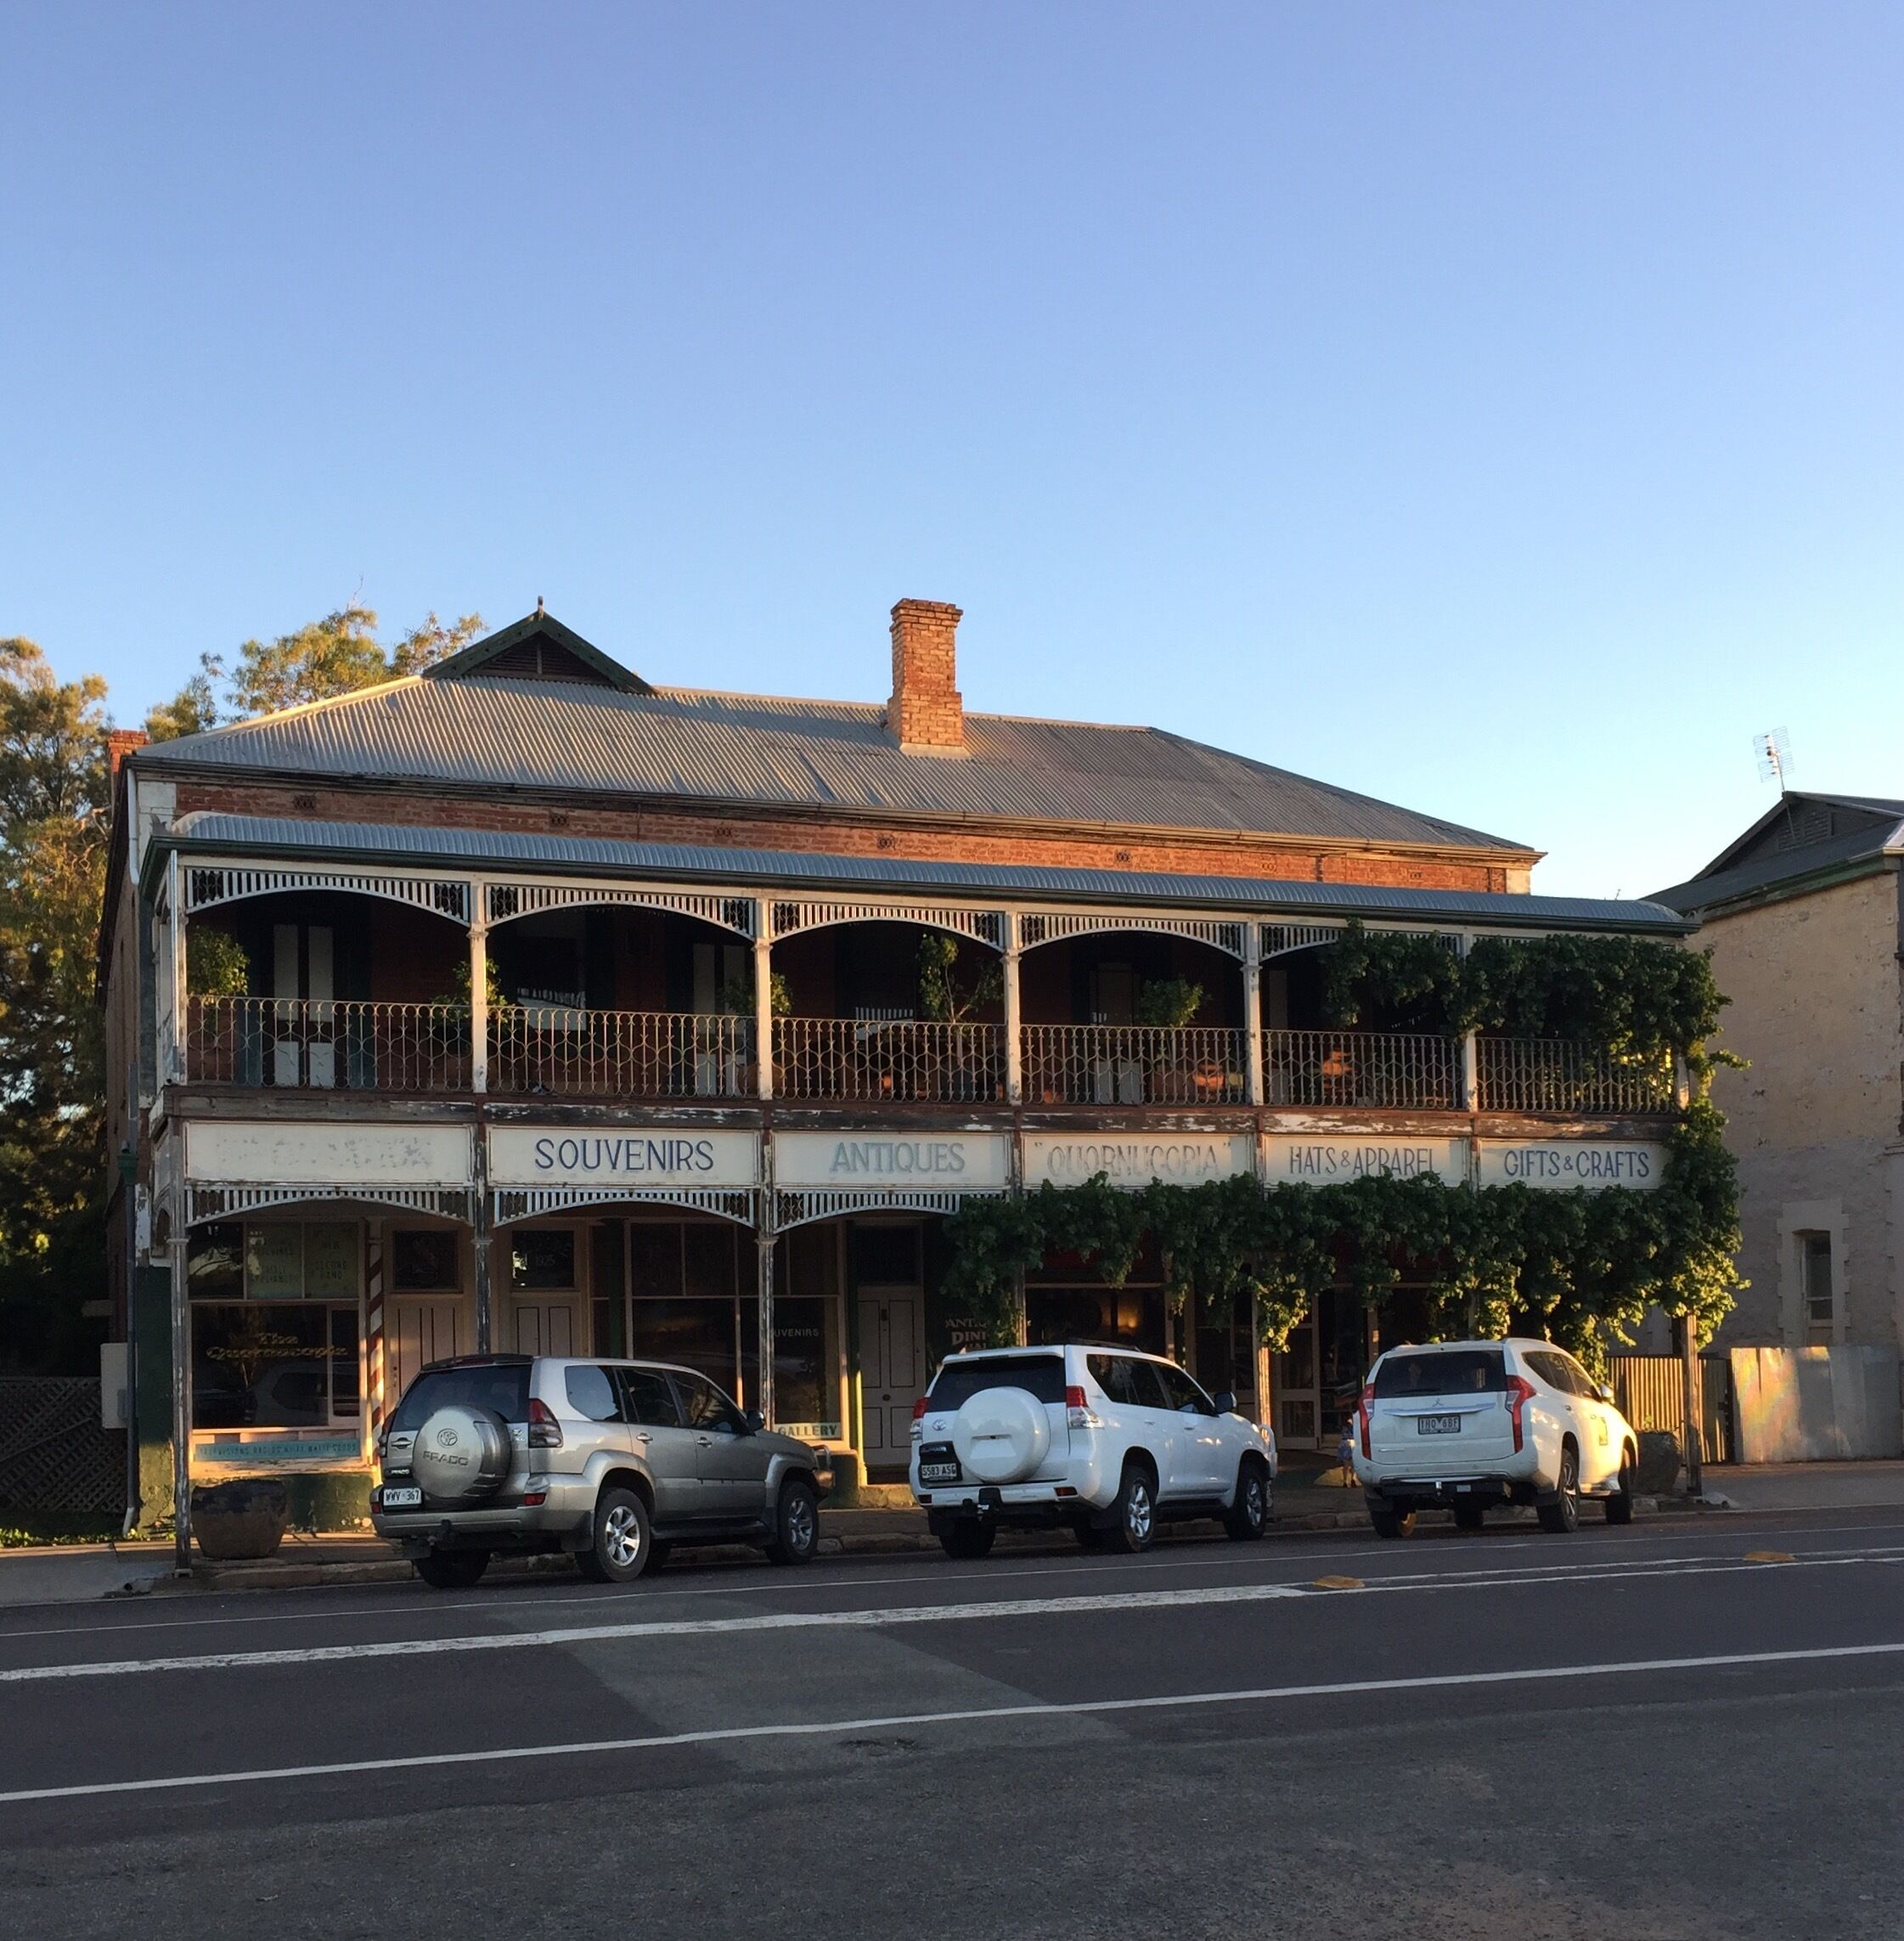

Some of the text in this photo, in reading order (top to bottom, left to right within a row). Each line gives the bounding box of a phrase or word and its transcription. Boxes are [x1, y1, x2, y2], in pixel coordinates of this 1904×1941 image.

[534, 1138, 714, 1171] SOUVENIRS
[829, 1142, 966, 1173] ANTIQUES
[774, 1328, 820, 1338] UVENIRS
[778, 1425, 837, 1437] GALLERY
